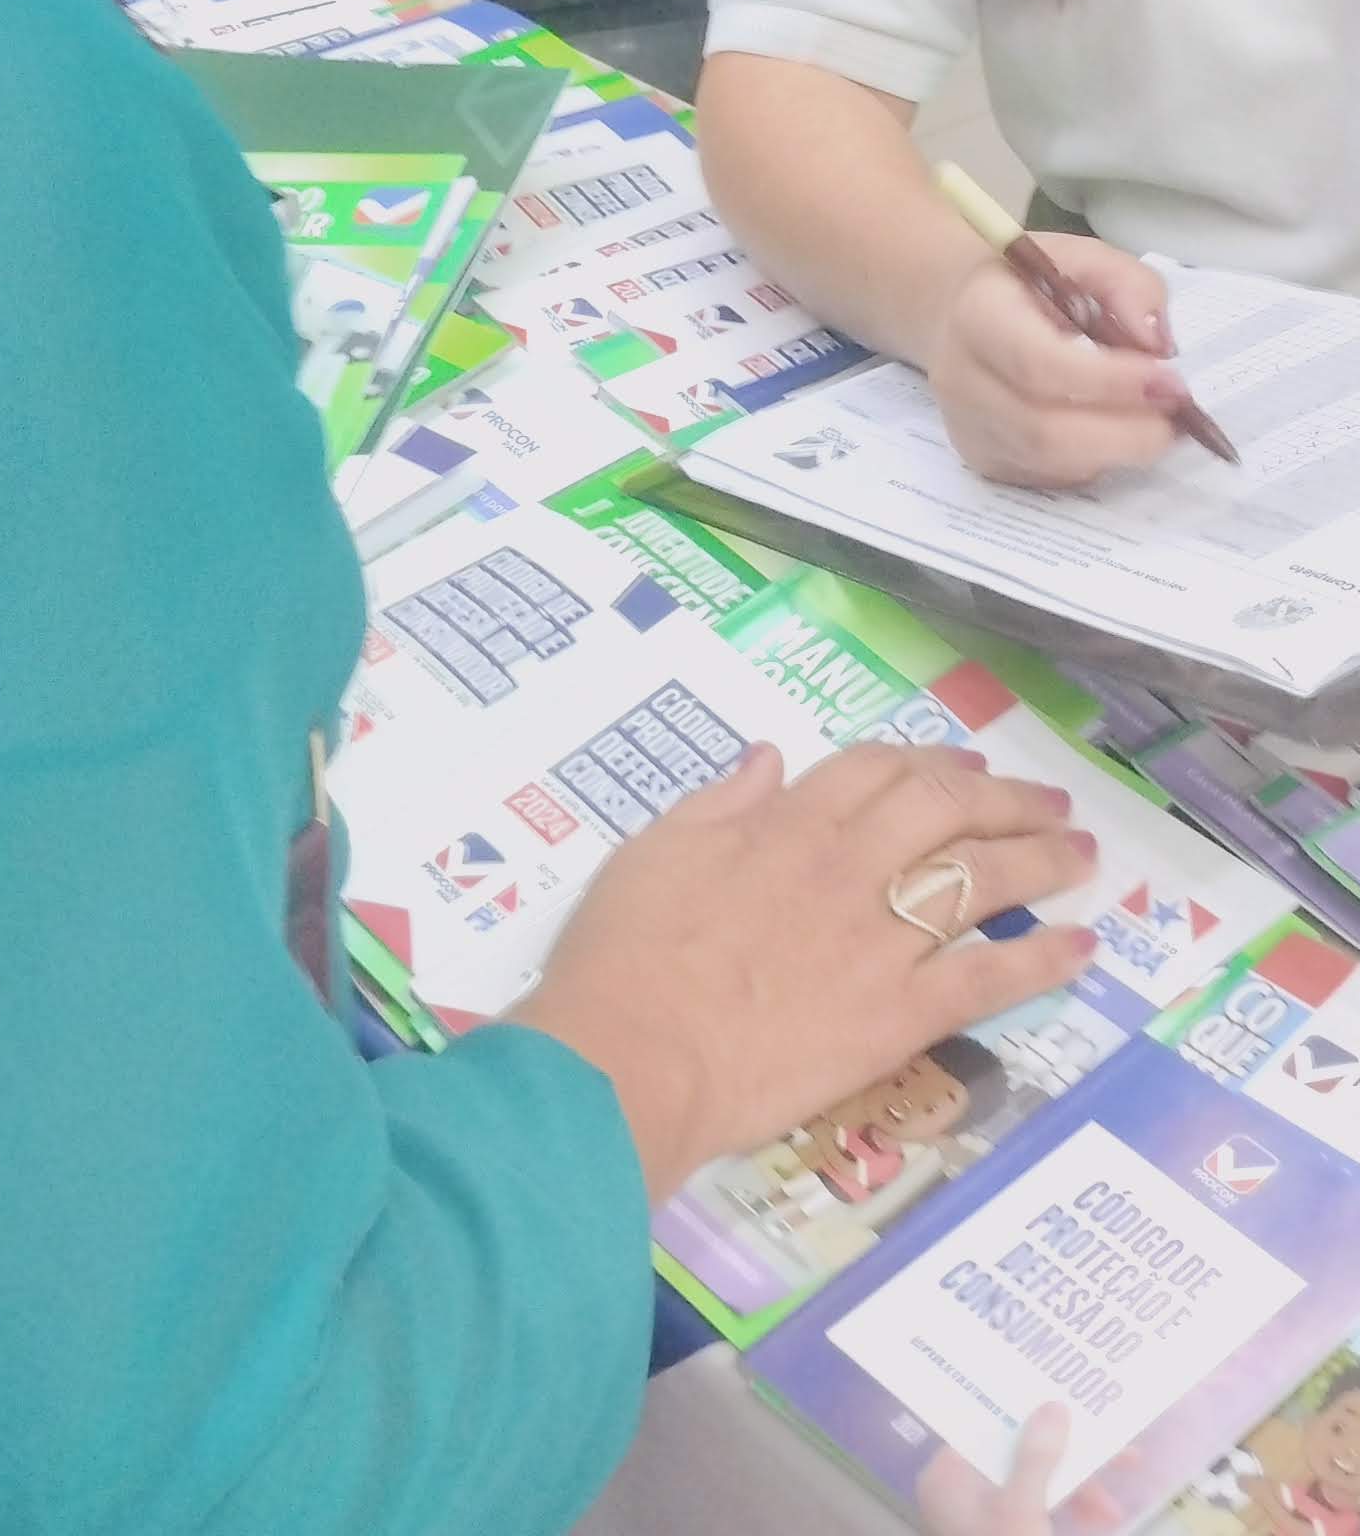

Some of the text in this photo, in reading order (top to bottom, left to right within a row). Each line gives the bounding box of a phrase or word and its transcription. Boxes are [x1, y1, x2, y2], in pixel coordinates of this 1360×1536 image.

[481, 409, 541, 454] PROCON
[1287, 564, 1357, 592] Completo
[650, 687, 743, 764] CÓDIGO
[1191, 1166, 1240, 1206] PROCON
[1024, 1203, 1194, 1340] PROTEÇÃO E
[1072, 1180, 1223, 1301] CÓDIGO DE
[938, 1259, 1125, 1417] CONSUMIDOR
[994, 1240, 1145, 1364] DEFESA DO
